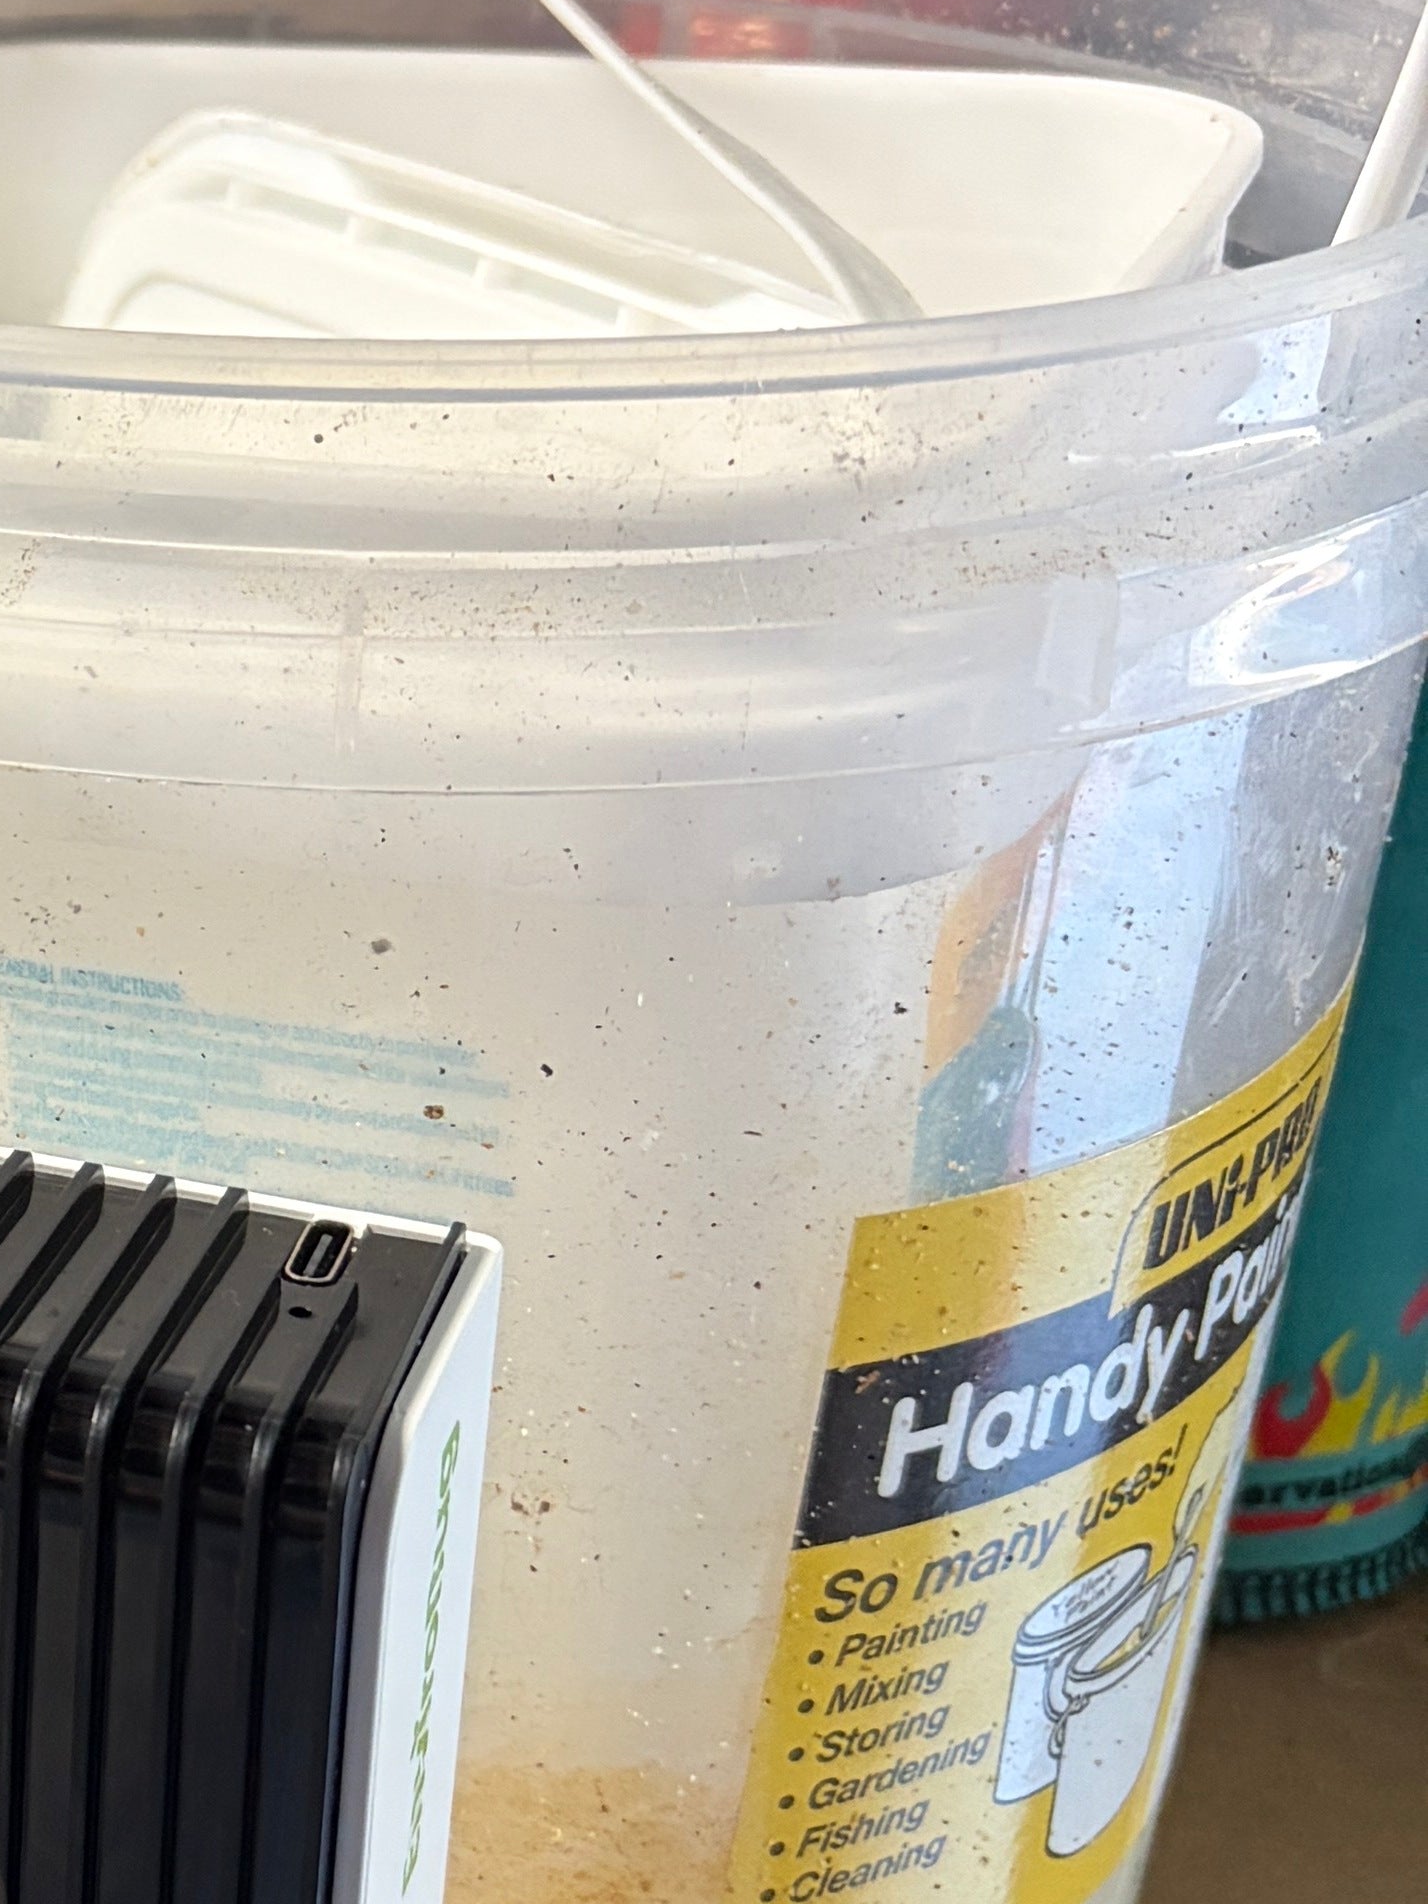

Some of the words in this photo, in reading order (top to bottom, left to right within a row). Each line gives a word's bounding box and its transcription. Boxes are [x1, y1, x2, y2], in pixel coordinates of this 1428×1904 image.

[878, 1302, 1190, 1498] Handy
[814, 1568, 899, 1624] So
[912, 1510, 1070, 1597] many
[1077, 1422, 1190, 1538] uses!
[834, 1598, 990, 1669] Painting
[824, 1658, 951, 1717] Mixing
[815, 1703, 952, 1764] Storing
[807, 1729, 992, 1811] Gardening
[795, 1798, 930, 1860] Fishing
[788, 1834, 947, 1904] Cleaning
